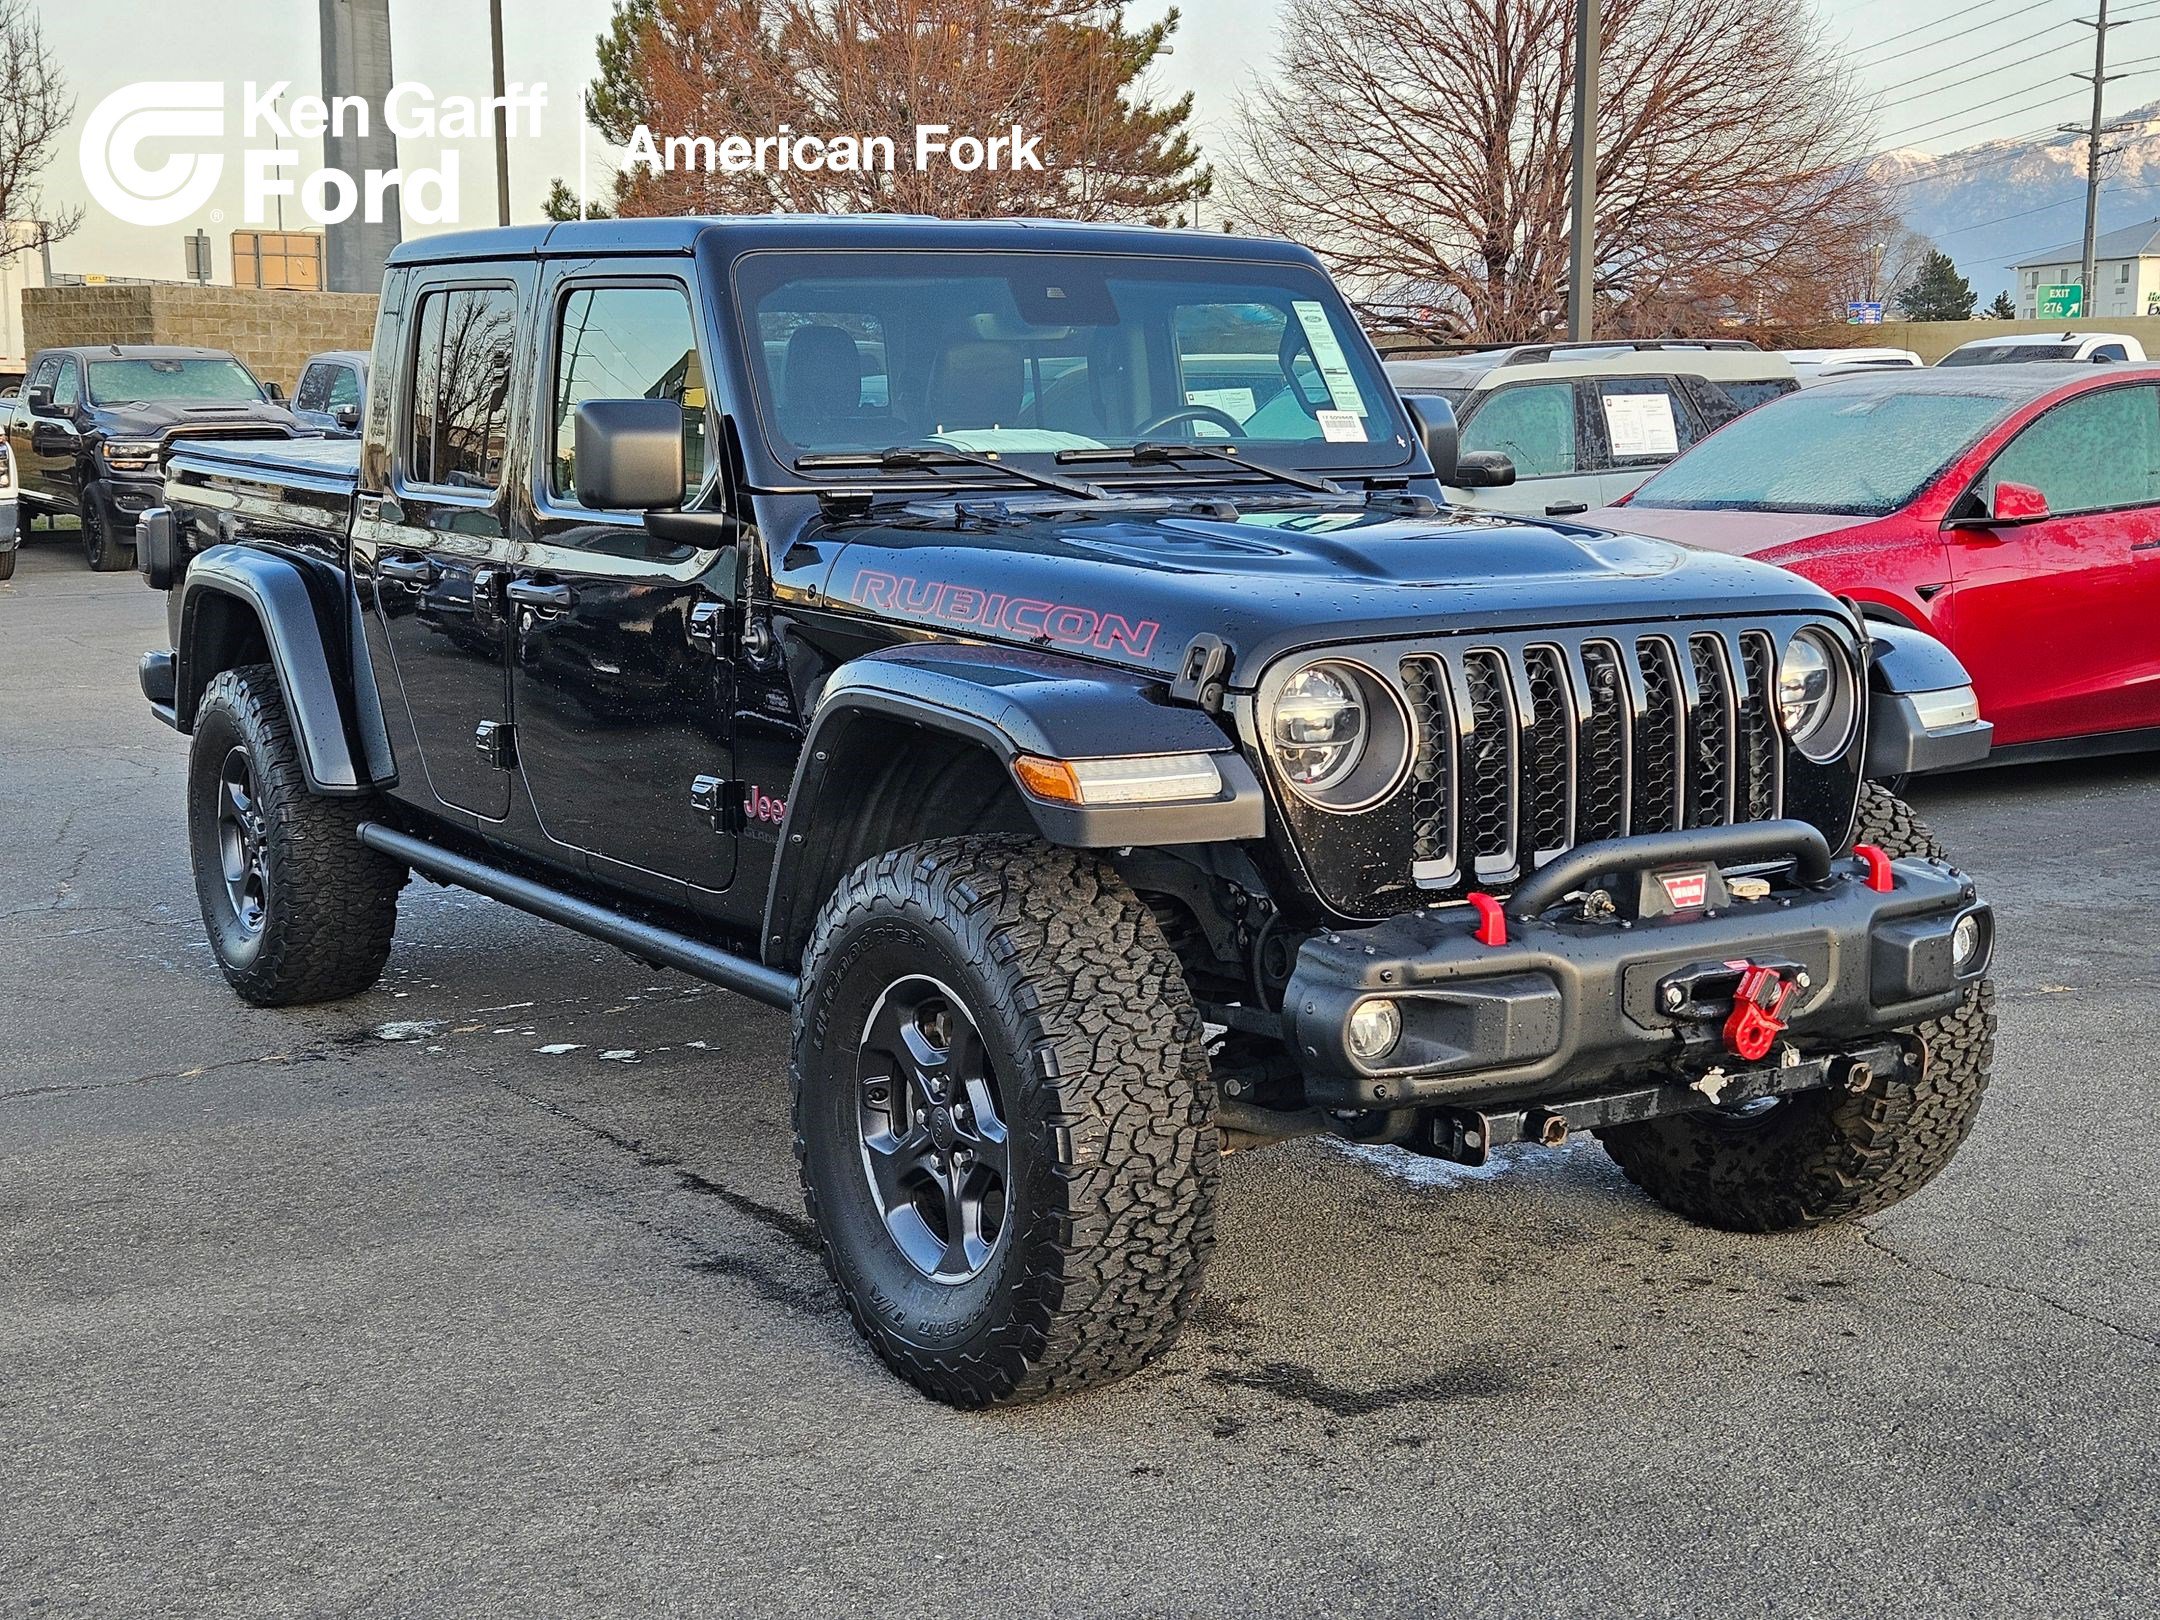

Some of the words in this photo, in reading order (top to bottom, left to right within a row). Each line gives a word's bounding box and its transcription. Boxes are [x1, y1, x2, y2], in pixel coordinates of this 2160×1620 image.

[2049, 289, 2071, 298] EXIT
[2043, 303, 2063, 313] 276
[851, 569, 1160, 658] RUBICON
[743, 785, 789, 825] Jee
